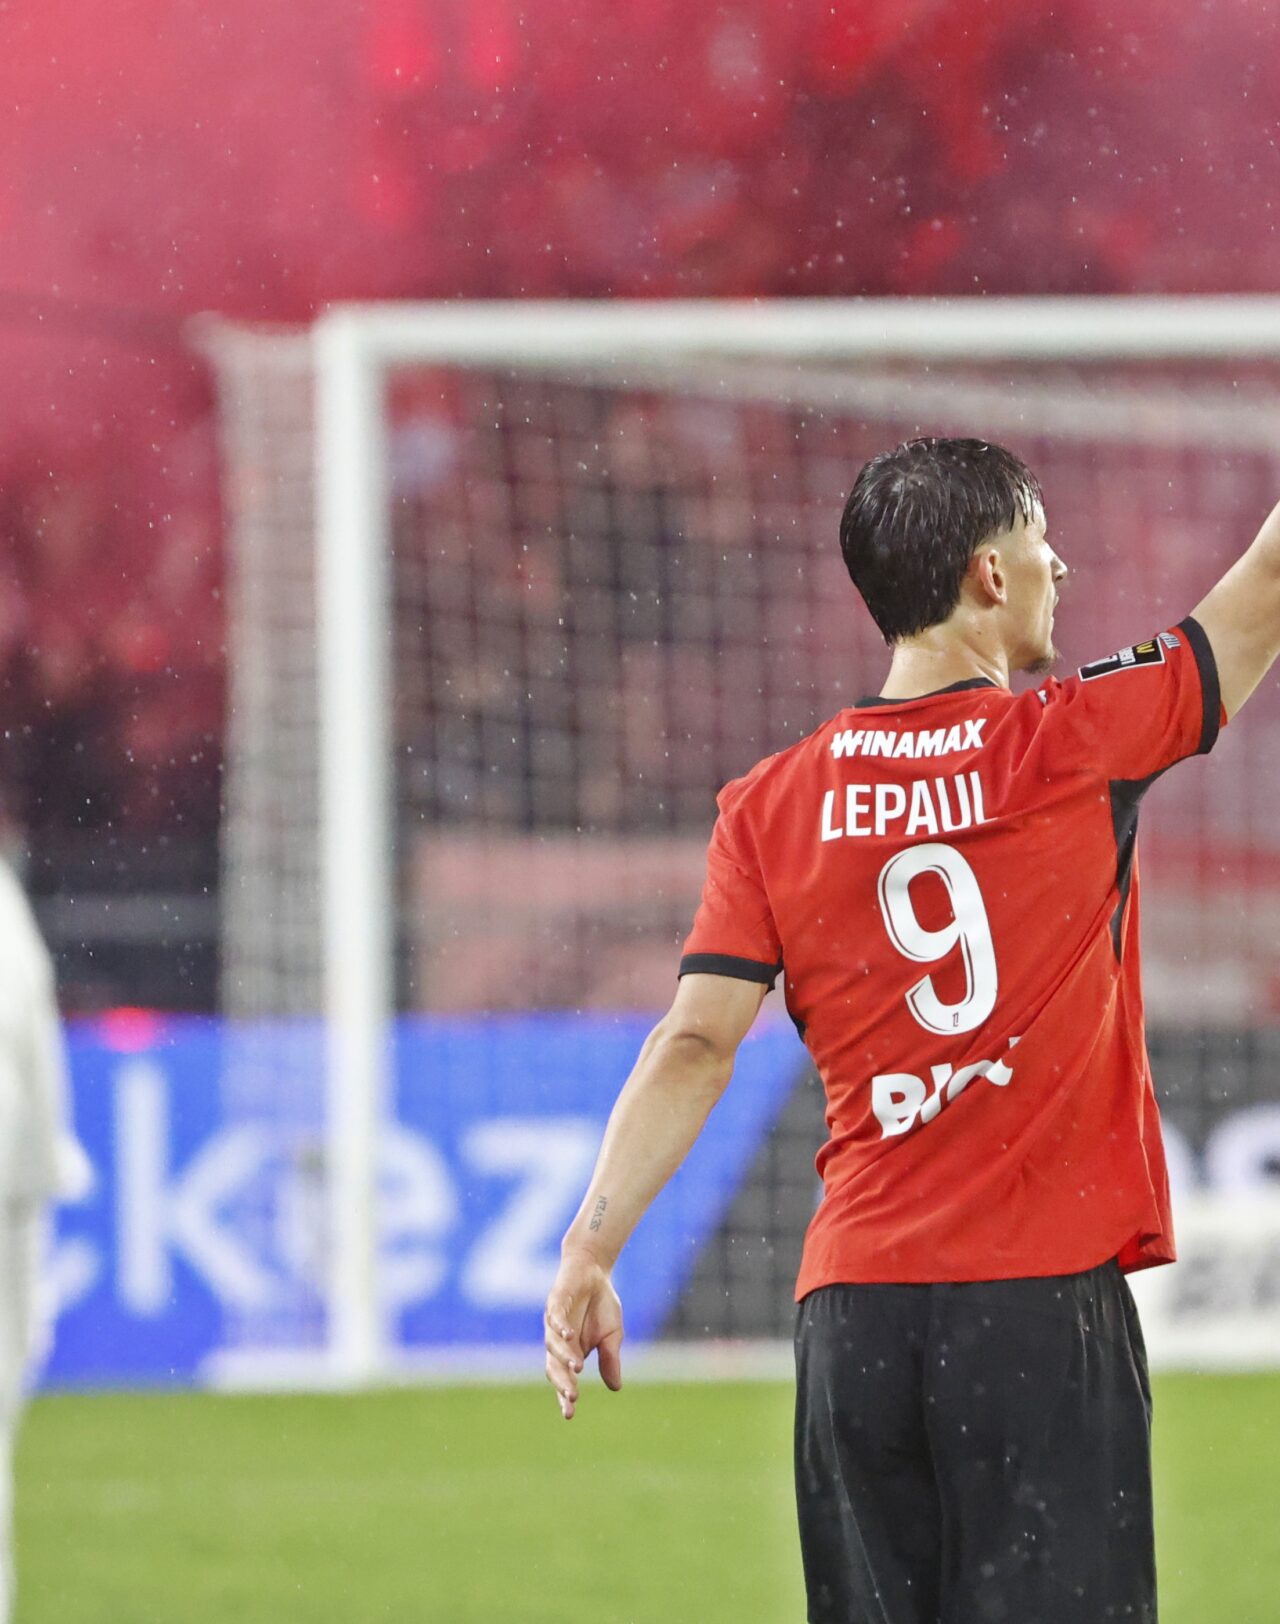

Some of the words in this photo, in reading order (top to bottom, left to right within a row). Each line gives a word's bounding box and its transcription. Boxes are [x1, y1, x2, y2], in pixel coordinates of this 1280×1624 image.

[831, 718, 986, 759] WINAMAX
[821, 771, 998, 842] LEPAUL
[877, 842, 998, 1035] 9
